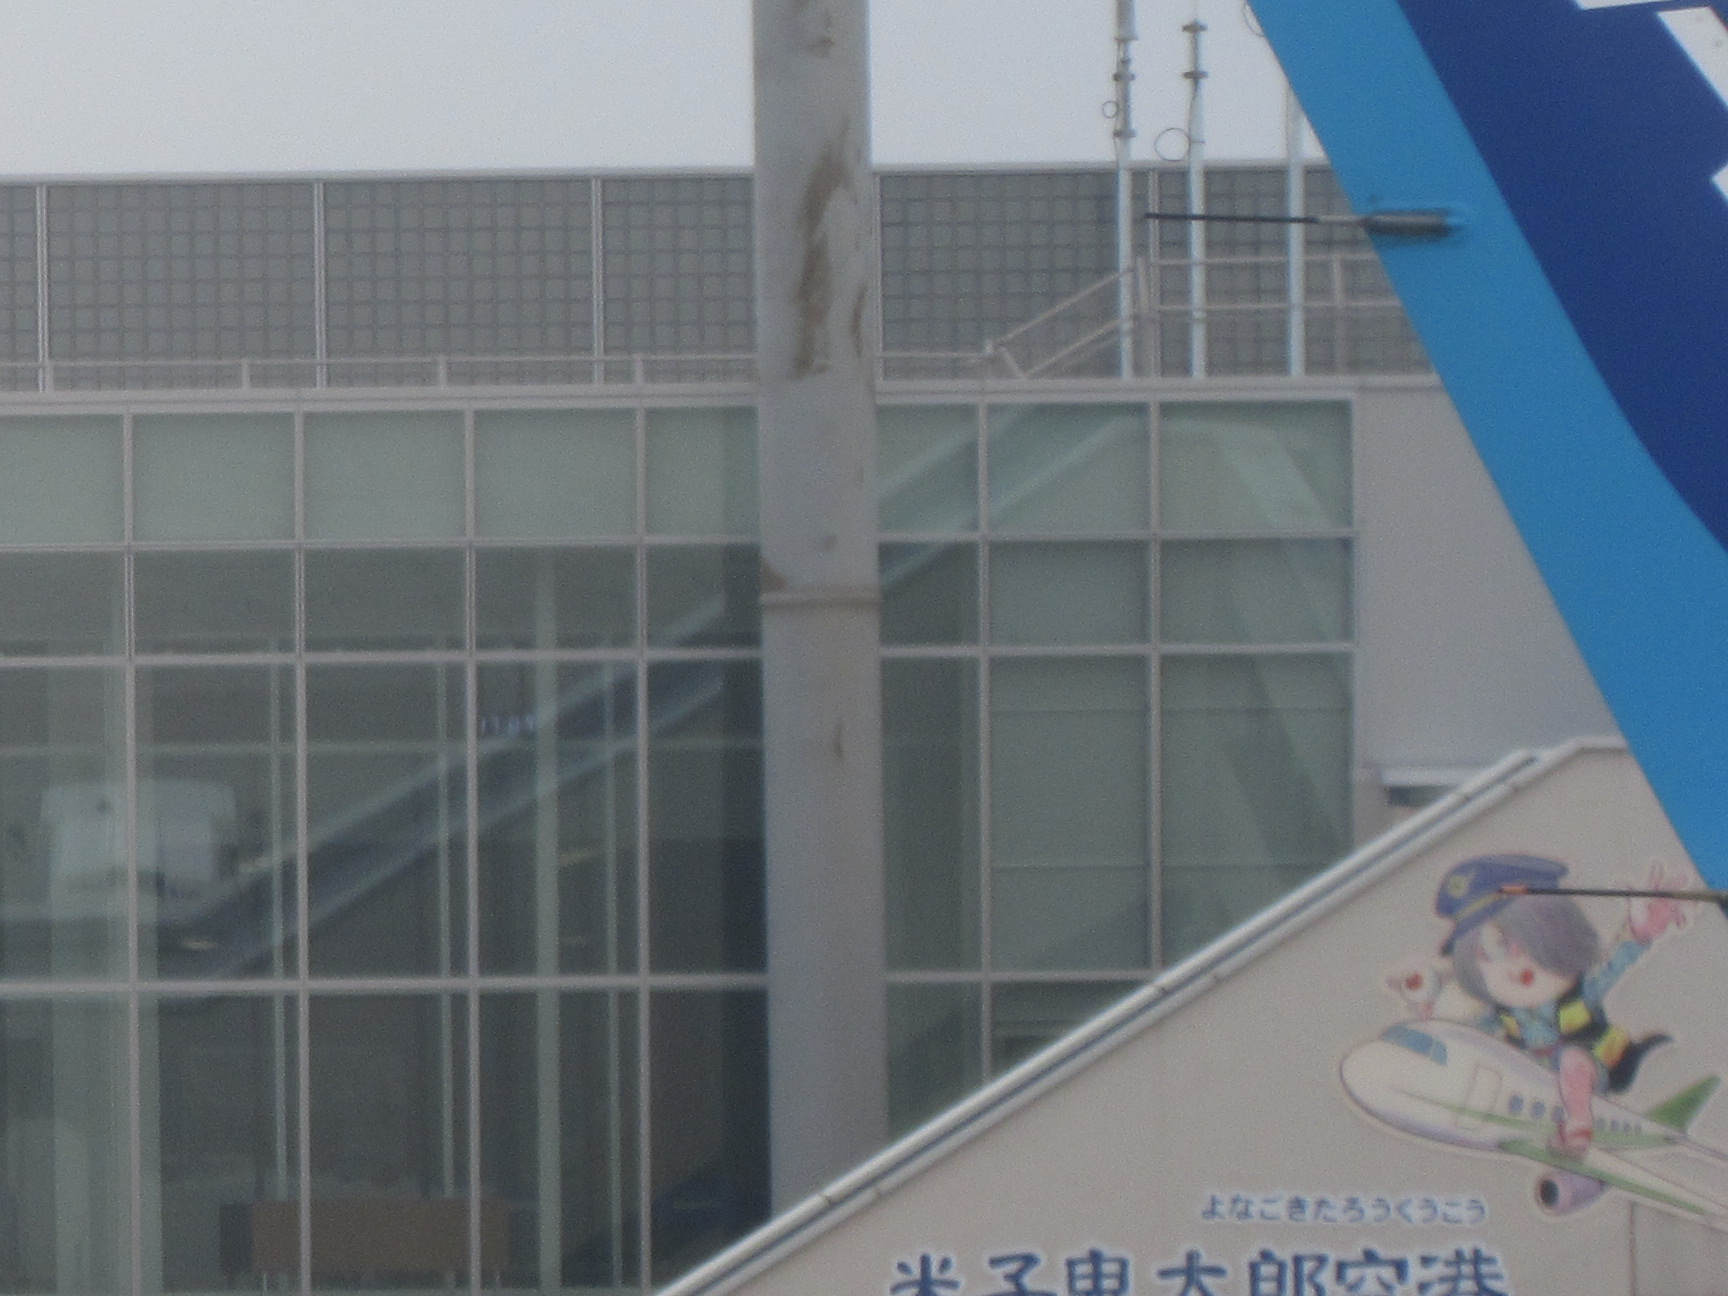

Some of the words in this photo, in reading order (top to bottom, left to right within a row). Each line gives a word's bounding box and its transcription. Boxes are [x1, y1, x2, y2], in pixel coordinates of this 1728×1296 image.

[1201, 1193, 1486, 1224] よなごきたろうくうこう
